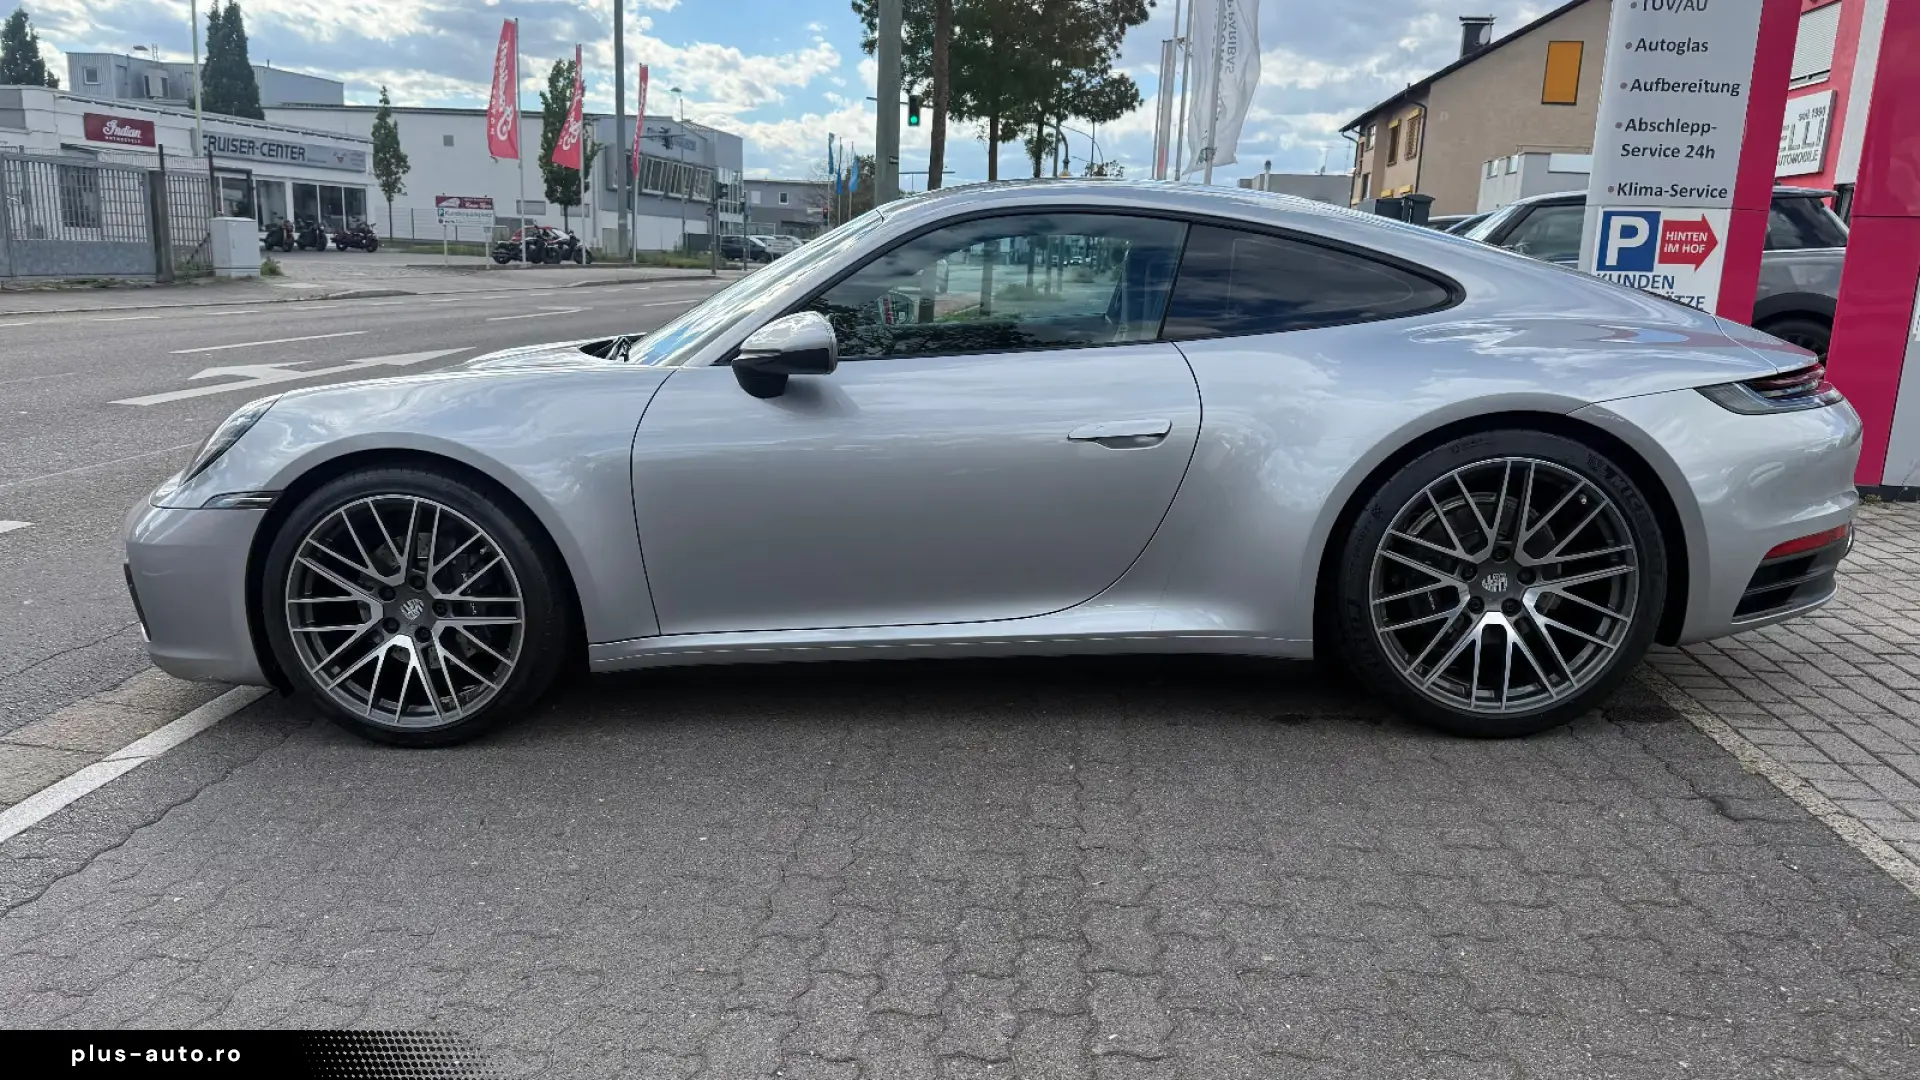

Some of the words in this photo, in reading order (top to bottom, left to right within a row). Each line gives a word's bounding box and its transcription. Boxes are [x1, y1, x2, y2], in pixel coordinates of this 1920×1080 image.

[1634, 37, 1709, 55] Autoglas
[1630, 77, 1741, 97] Aufbereitung
[103, 119, 142, 139] Indian
[1625, 117, 1718, 136] Abschlepp-
[1620, 143, 1681, 158] Service
[1684, 144, 1716, 159] 24h
[1777, 149, 1819, 167] UTOMOBILE
[1617, 182, 1728, 198] Klima-Service
[1605, 215, 1650, 266] P
[1666, 231, 1708, 242] HINTEN
[1664, 243, 1680, 253] IM
[1682, 243, 1706, 254] HOF
[1597, 273, 1675, 289] UNDEN
